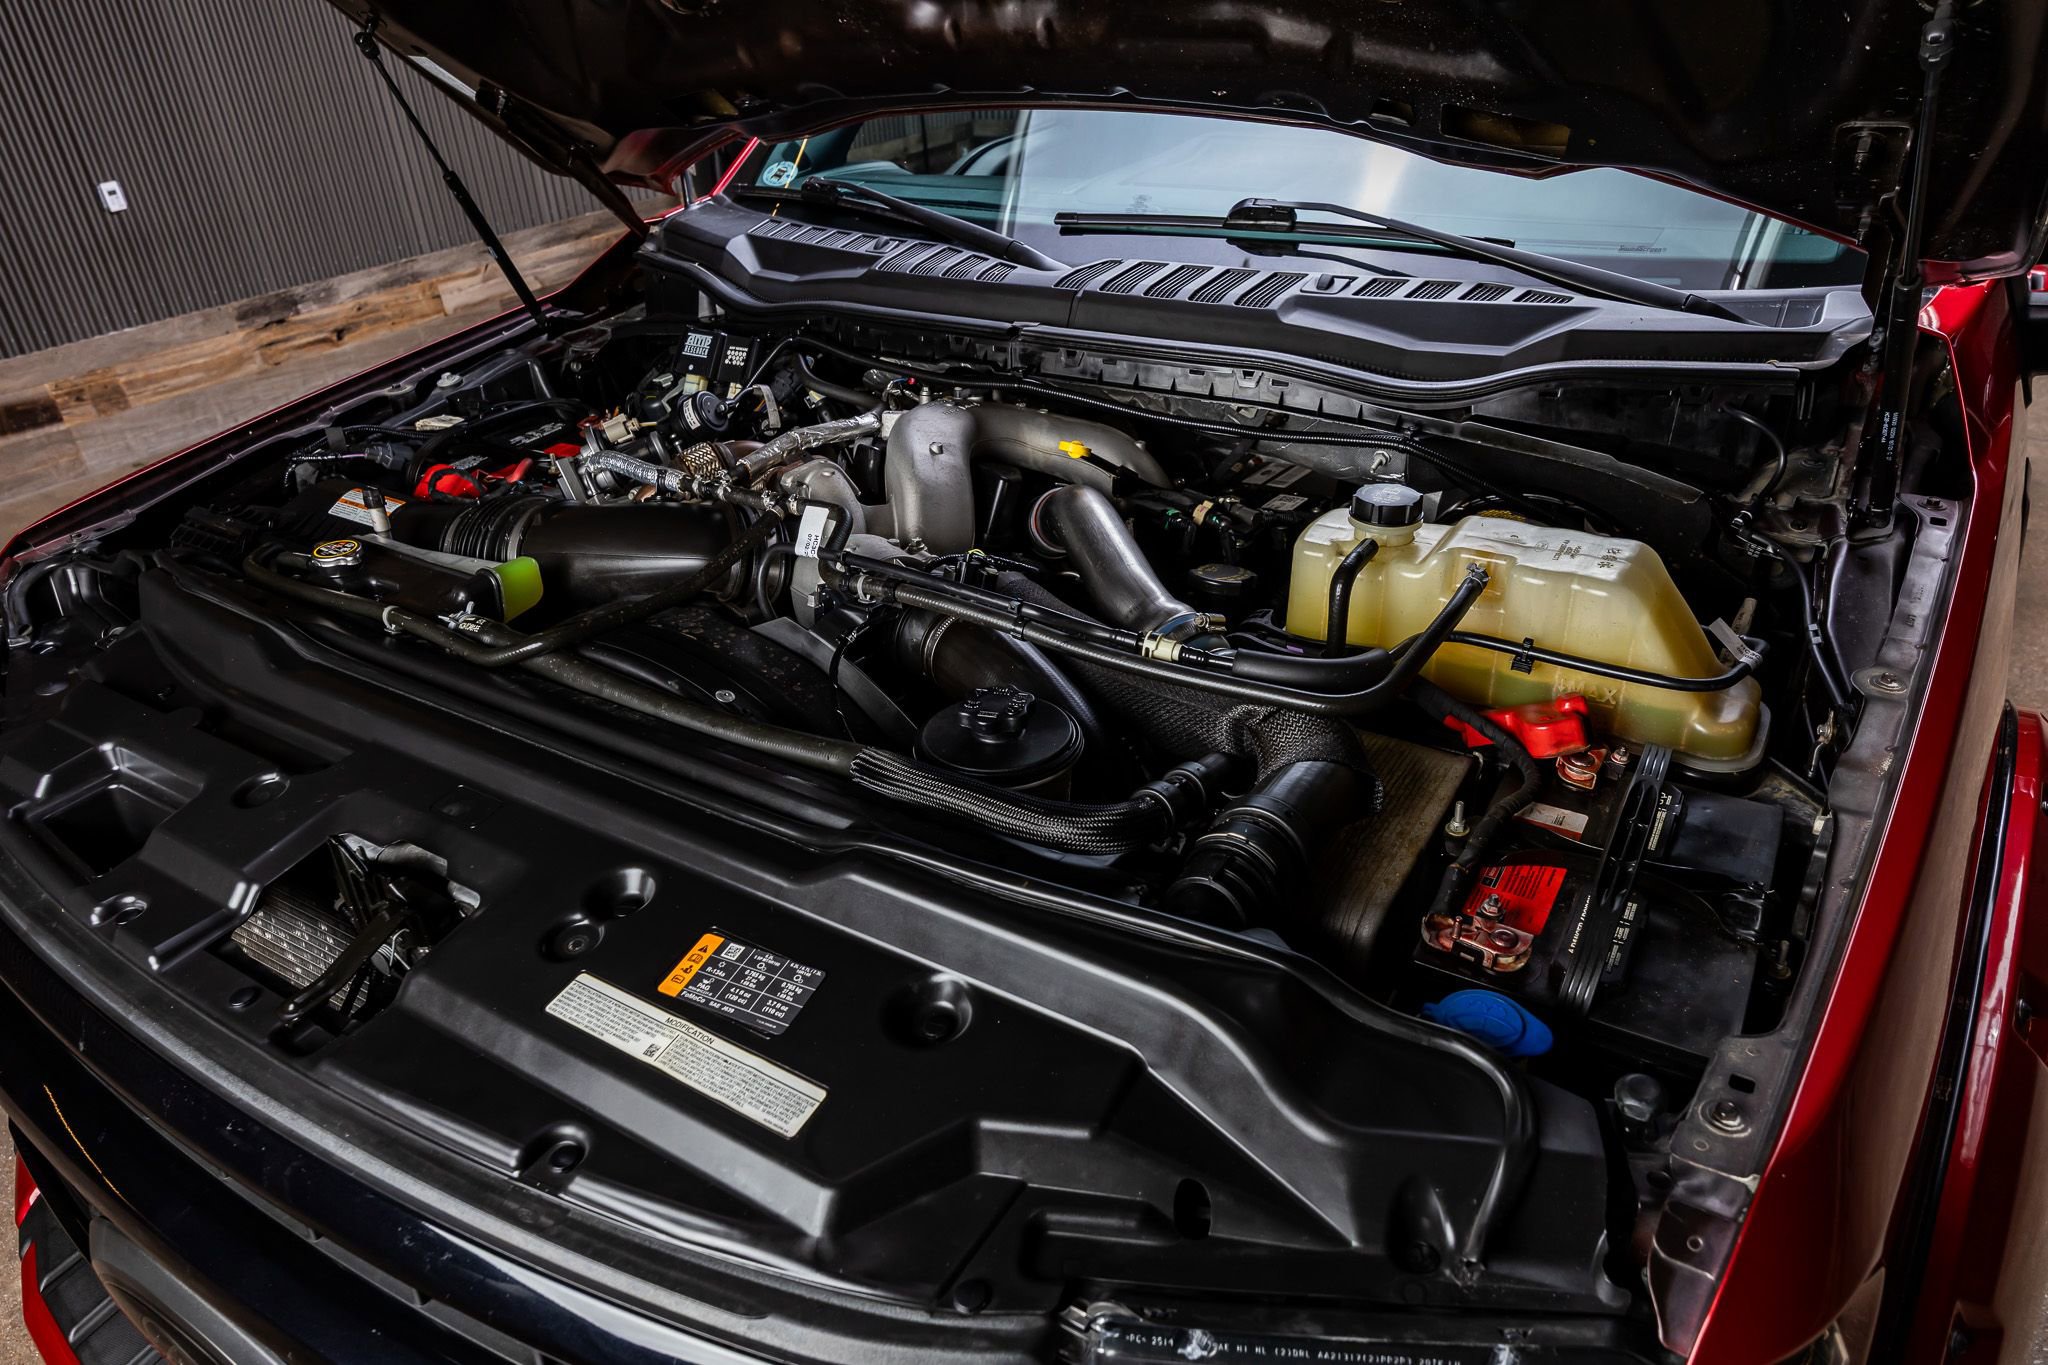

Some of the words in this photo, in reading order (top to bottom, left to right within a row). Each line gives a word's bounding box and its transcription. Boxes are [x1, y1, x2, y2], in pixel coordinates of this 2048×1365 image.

[684, 345, 709, 356] RESEARCH
[680, 990, 706, 1003] FoMoCo
[665, 1016, 715, 1046] MODIFICATION
